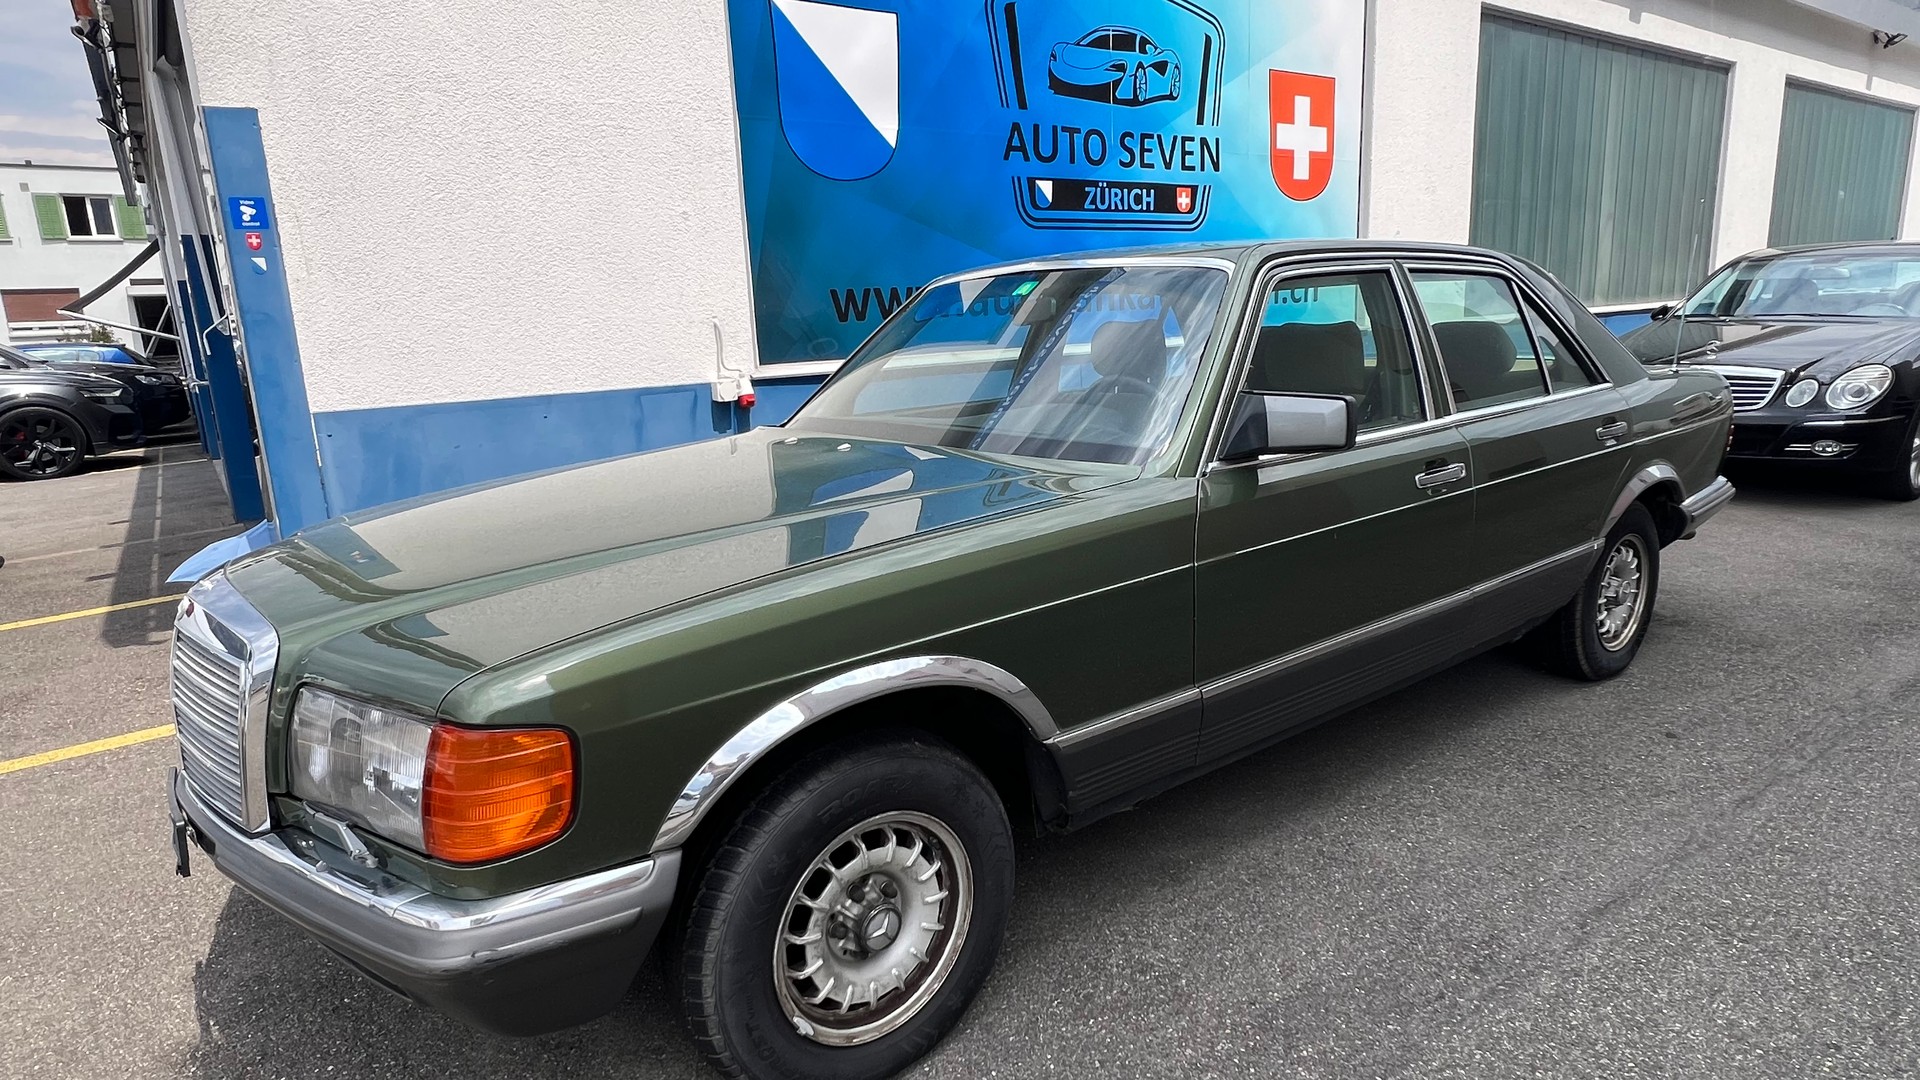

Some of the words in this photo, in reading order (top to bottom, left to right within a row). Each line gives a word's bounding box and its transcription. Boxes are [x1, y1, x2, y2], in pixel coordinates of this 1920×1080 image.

[1003, 121, 1107, 167] AUTO
[1119, 131, 1221, 173] SEVEN
[1083, 182, 1155, 211] ZÜRICH
